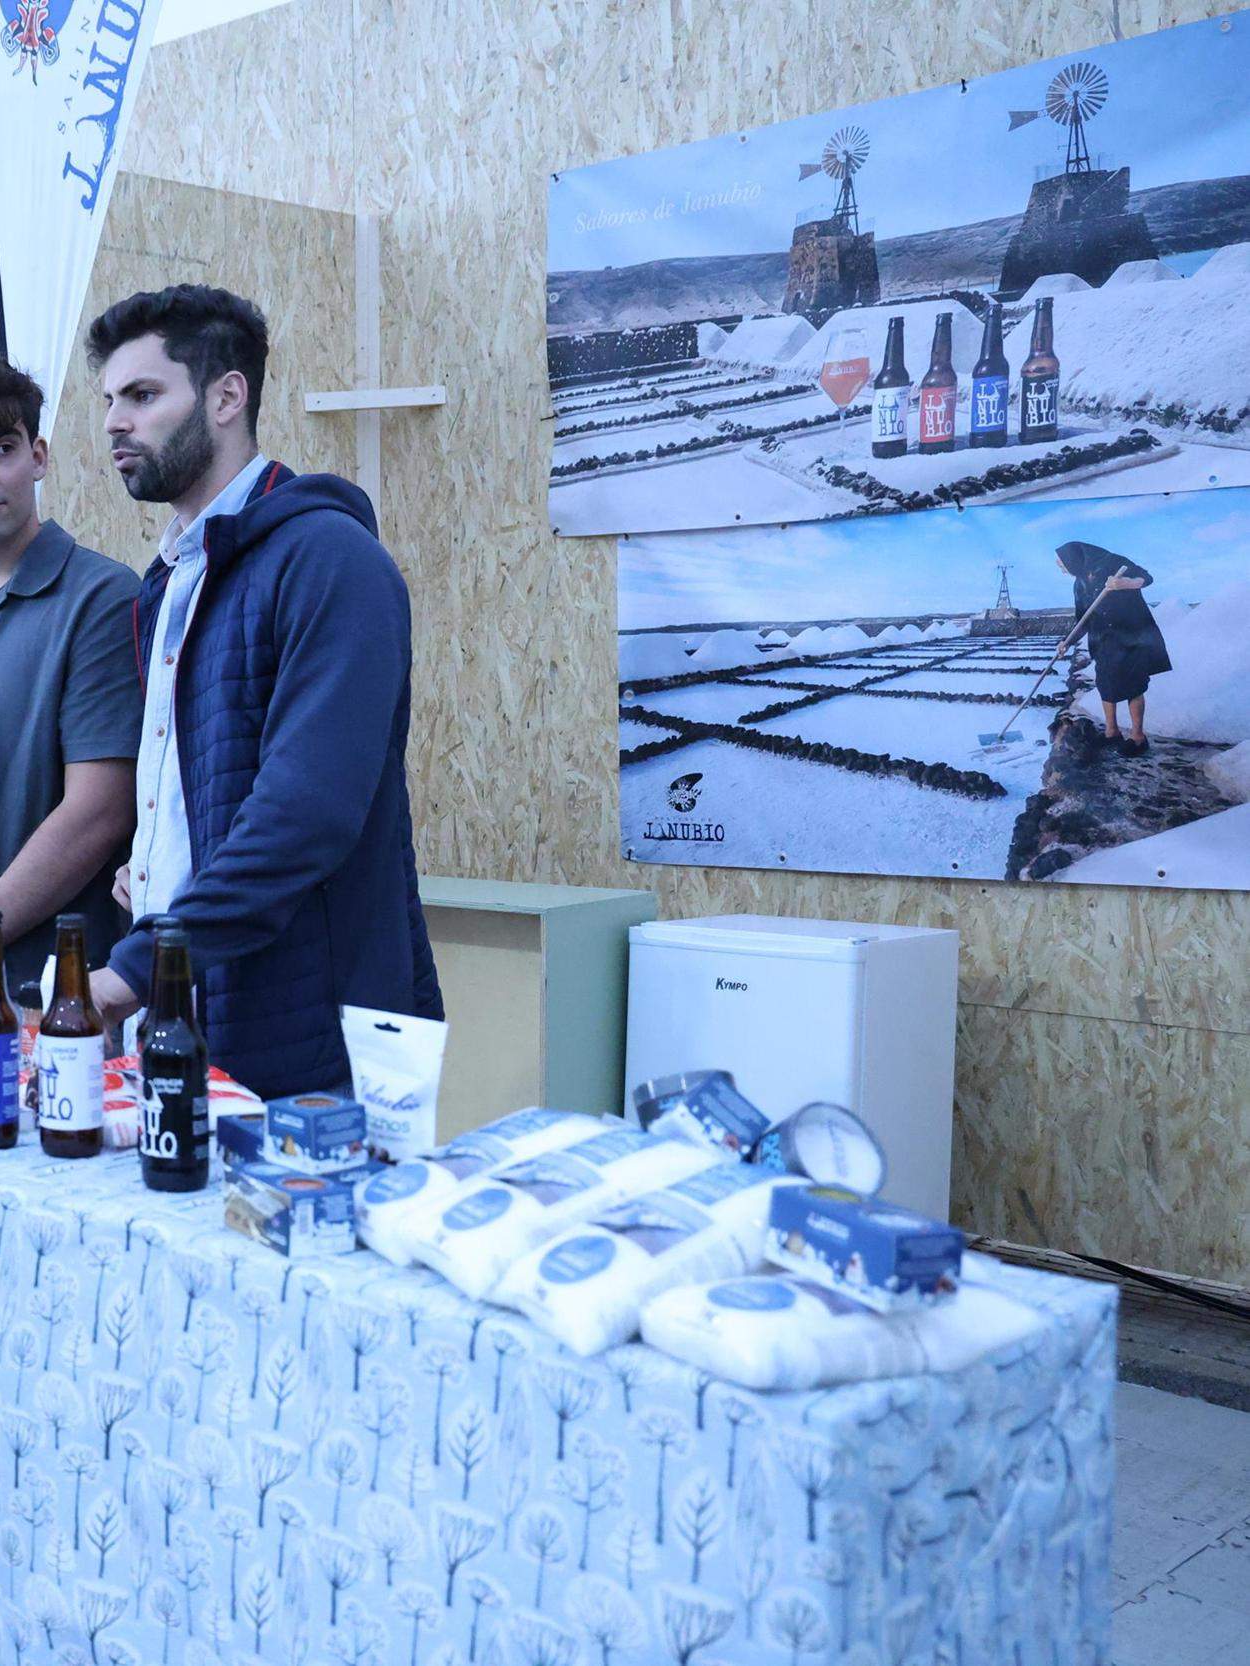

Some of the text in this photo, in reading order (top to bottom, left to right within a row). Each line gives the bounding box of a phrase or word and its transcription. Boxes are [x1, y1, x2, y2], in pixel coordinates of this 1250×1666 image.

[57, 0, 97, 135] SALIN
[574, 180, 763, 234] Sabores de Janubio
